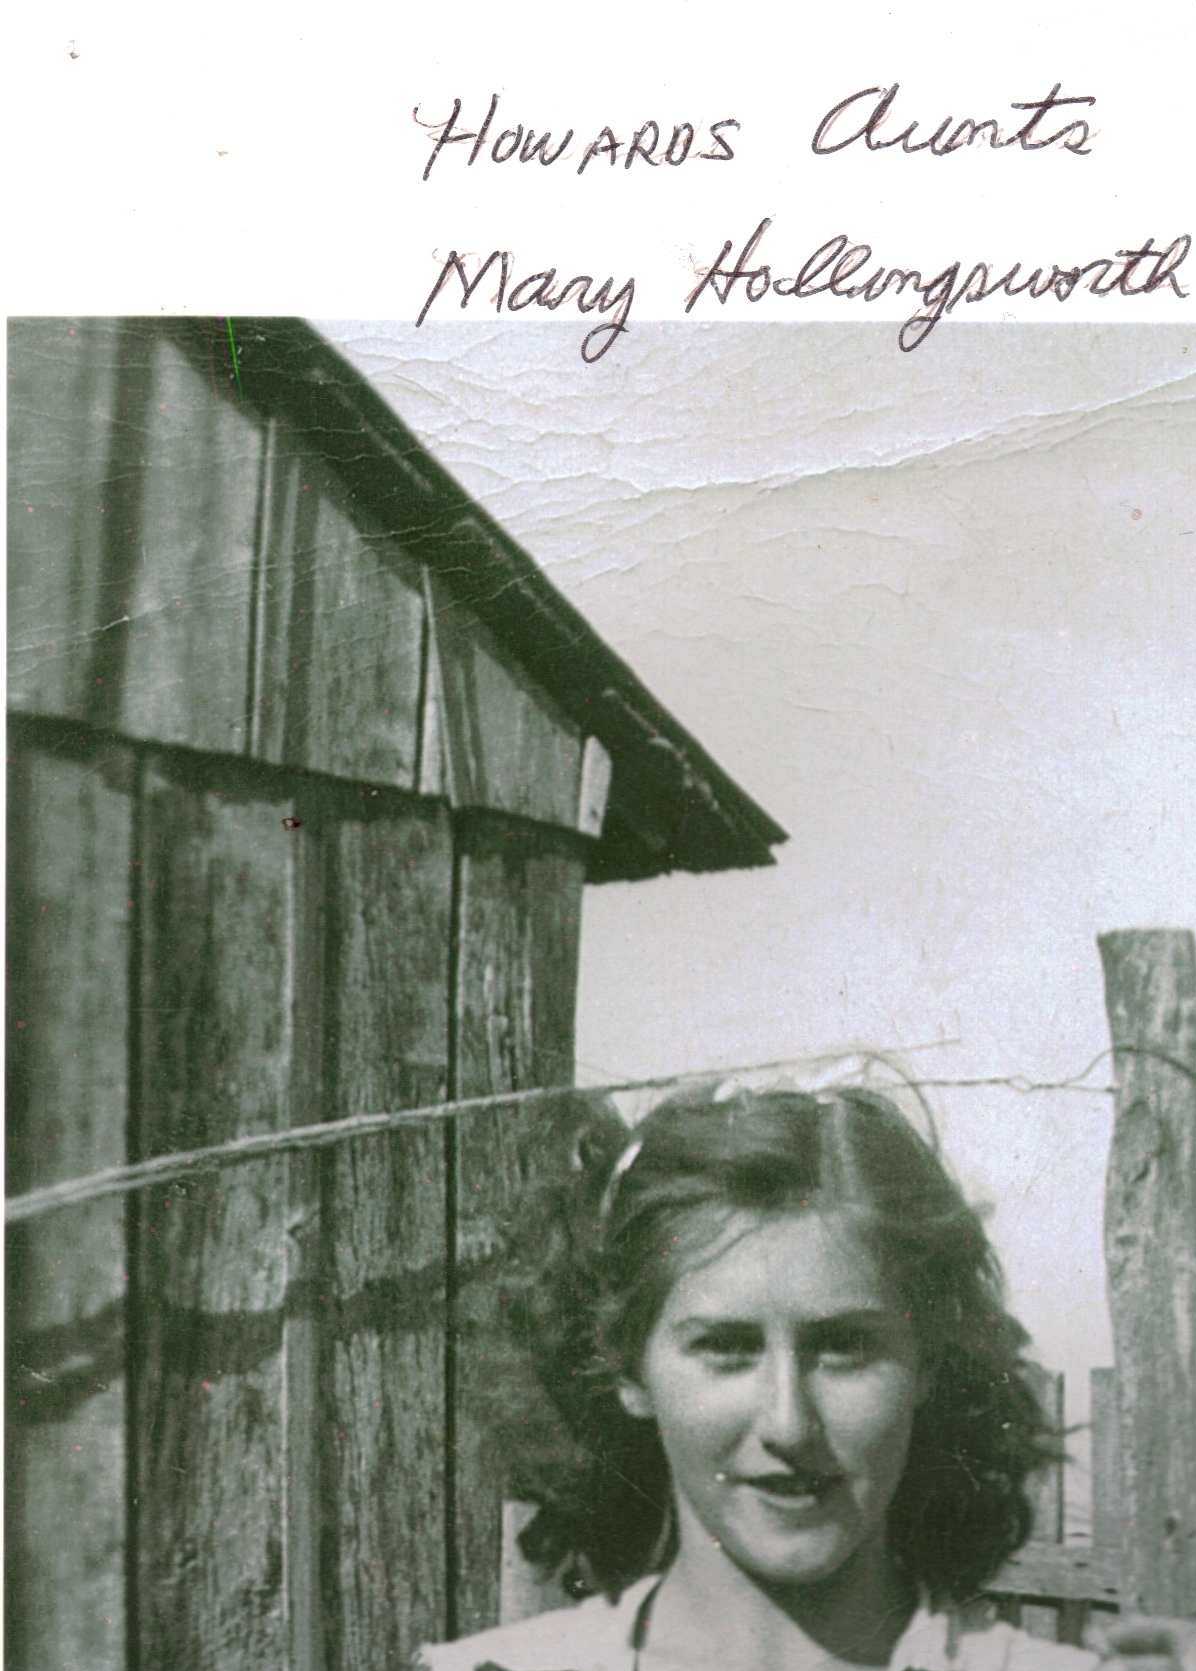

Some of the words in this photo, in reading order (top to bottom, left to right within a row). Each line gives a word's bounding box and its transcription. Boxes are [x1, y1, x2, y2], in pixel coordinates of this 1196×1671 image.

[811, 82, 1098, 157] Aunts
[415, 250, 635, 364] Mary
[686, 217, 1192, 353] Hollingsworth
